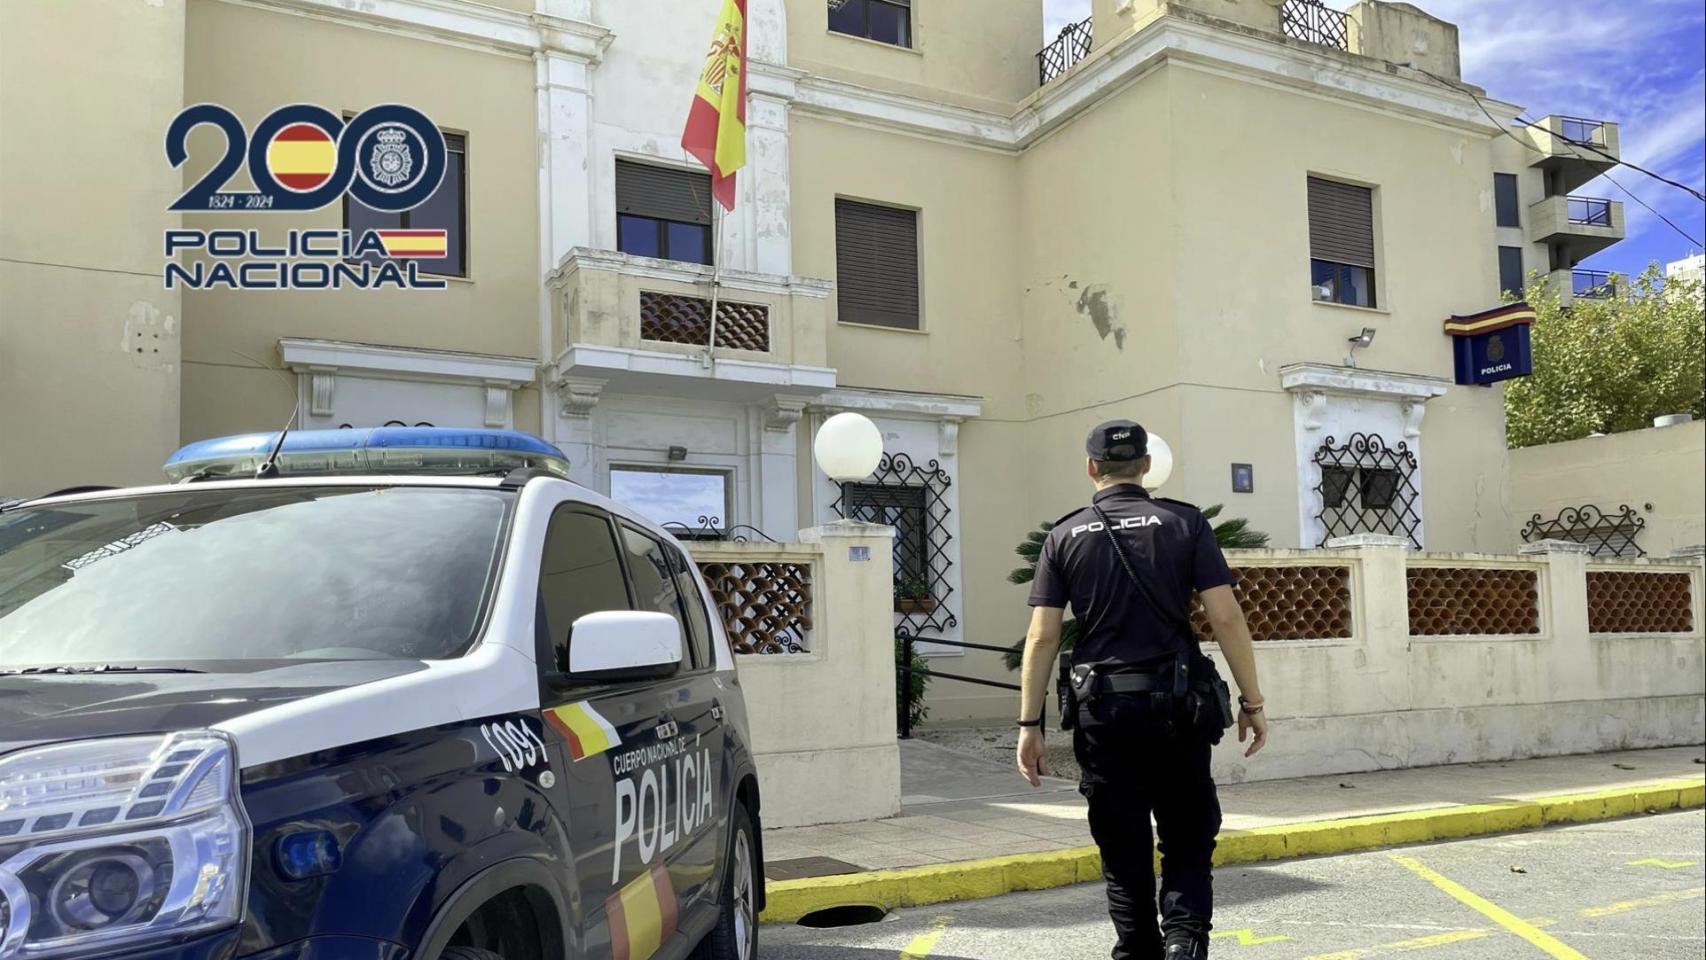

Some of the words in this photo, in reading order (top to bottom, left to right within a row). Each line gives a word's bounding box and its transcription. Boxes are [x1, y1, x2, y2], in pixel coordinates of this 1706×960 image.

[1481, 363, 1511, 375] POLICIA
[613, 747, 647, 775] CUERPO
[647, 739, 679, 764] NACIONAL
[678, 735, 687, 753] DE
[611, 733, 713, 885] POLICÍA
